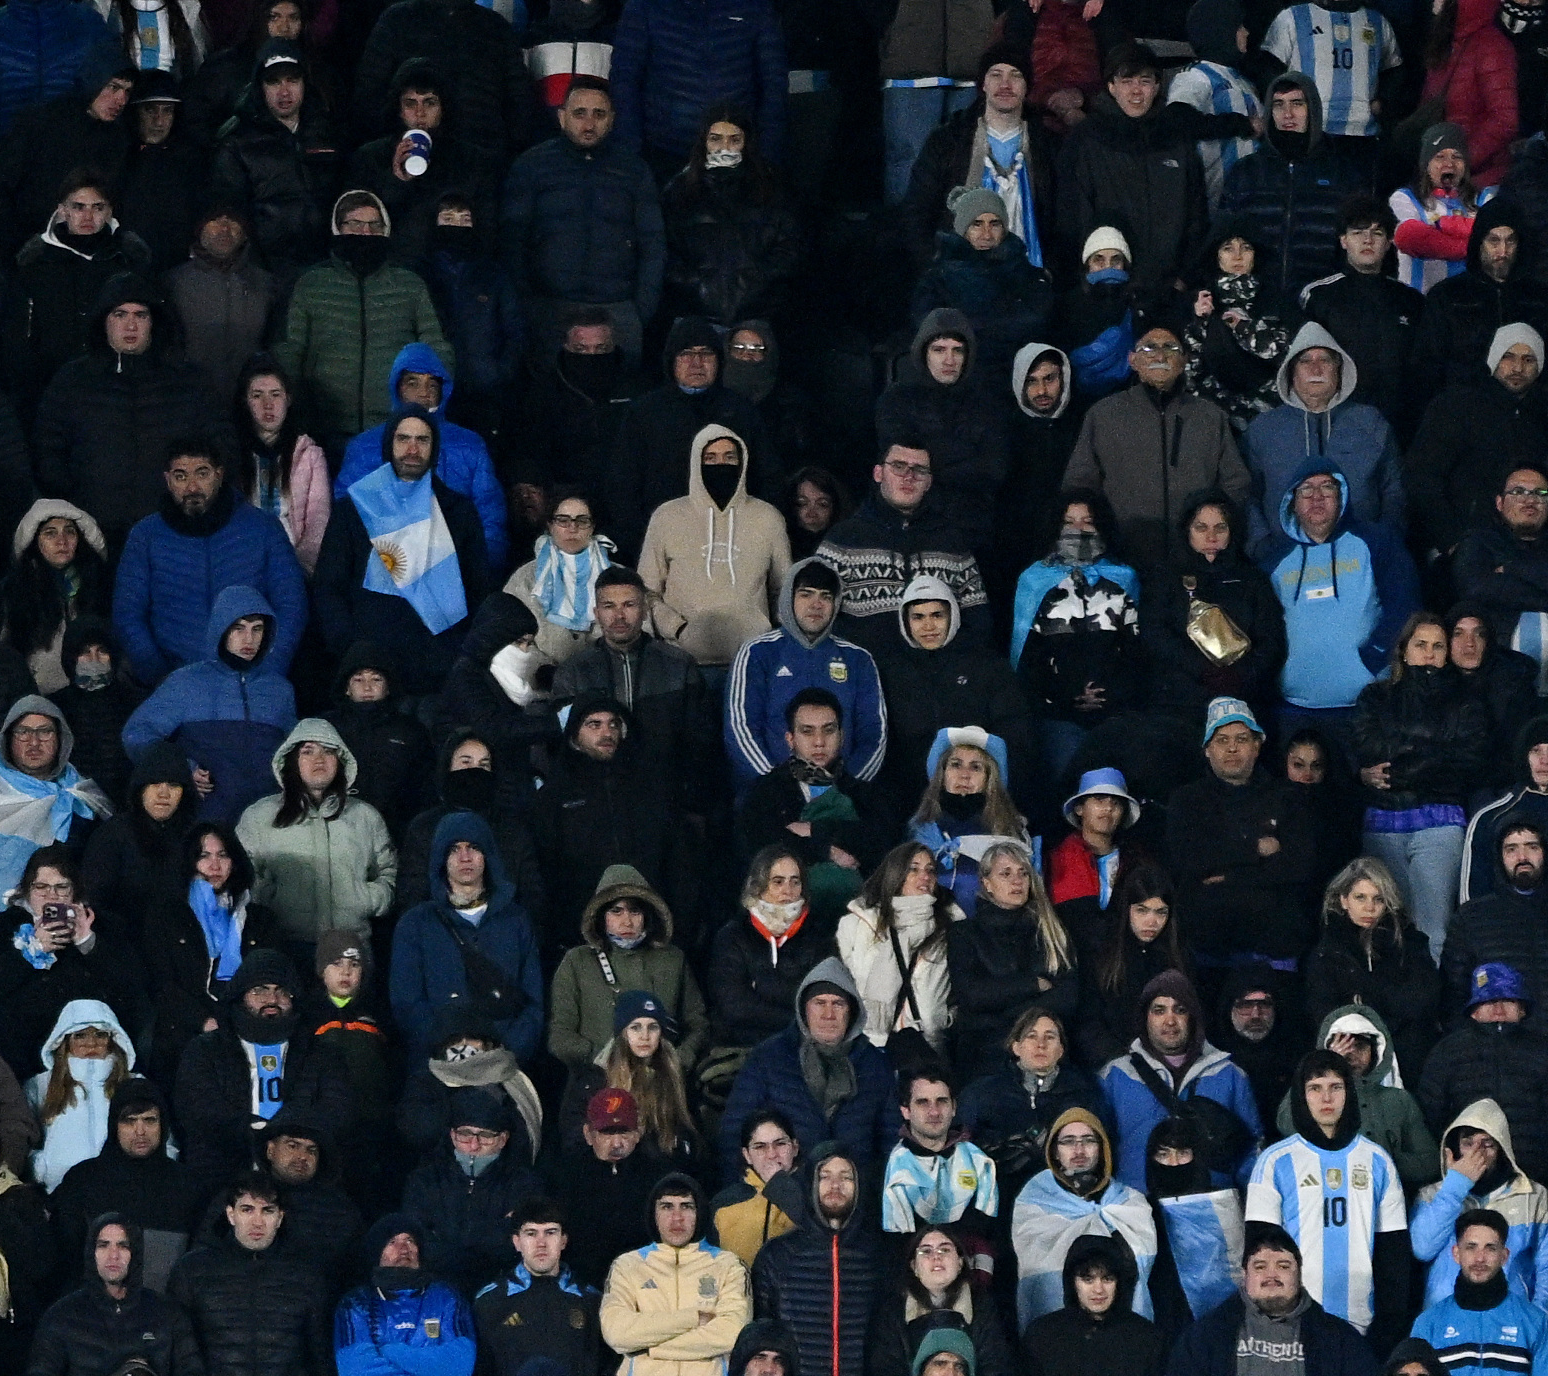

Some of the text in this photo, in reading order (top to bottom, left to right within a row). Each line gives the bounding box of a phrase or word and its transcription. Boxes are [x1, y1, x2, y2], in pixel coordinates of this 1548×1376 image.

[1332, 48, 1353, 69] 10
[259, 1077, 281, 1103] 10
[1323, 1196, 1347, 1227] 10
